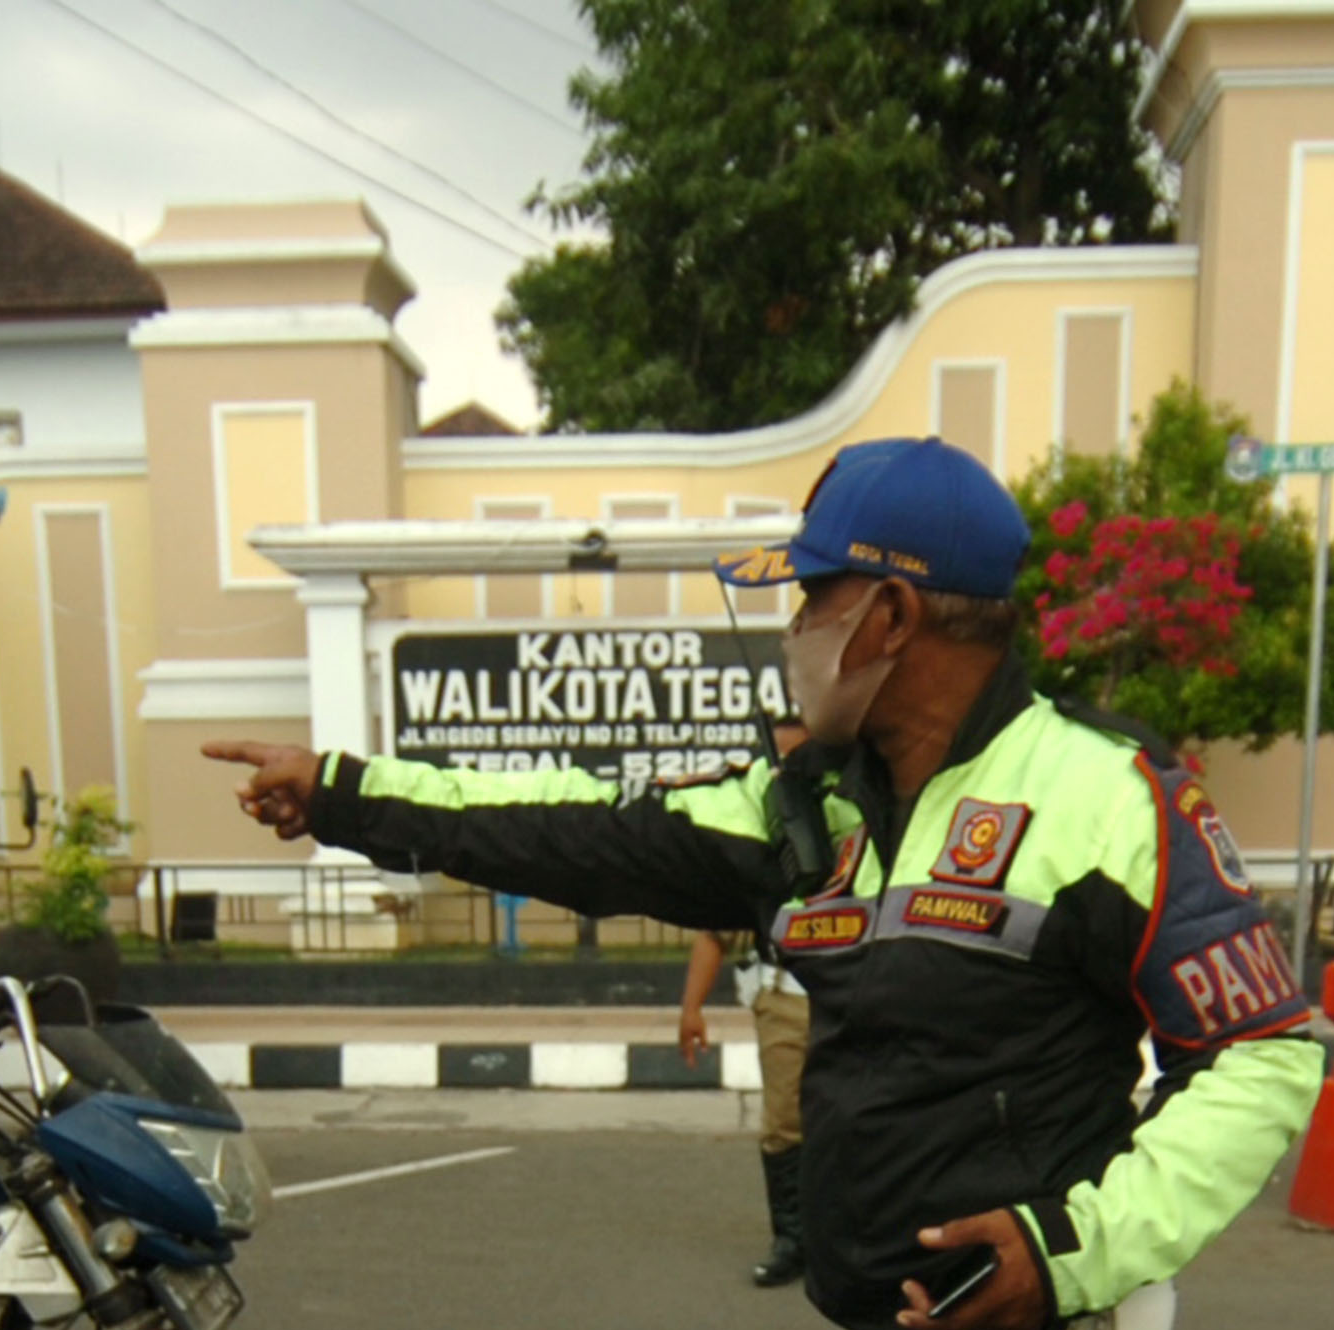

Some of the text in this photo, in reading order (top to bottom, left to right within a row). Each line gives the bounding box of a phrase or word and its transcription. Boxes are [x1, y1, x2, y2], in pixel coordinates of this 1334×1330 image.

[517, 631, 702, 669] KANTOR
[401, 666, 803, 722] WALIKOTA TEGA
[501, 725, 581, 747] SEBAYU
[910, 895, 990, 925] PAMWAL
